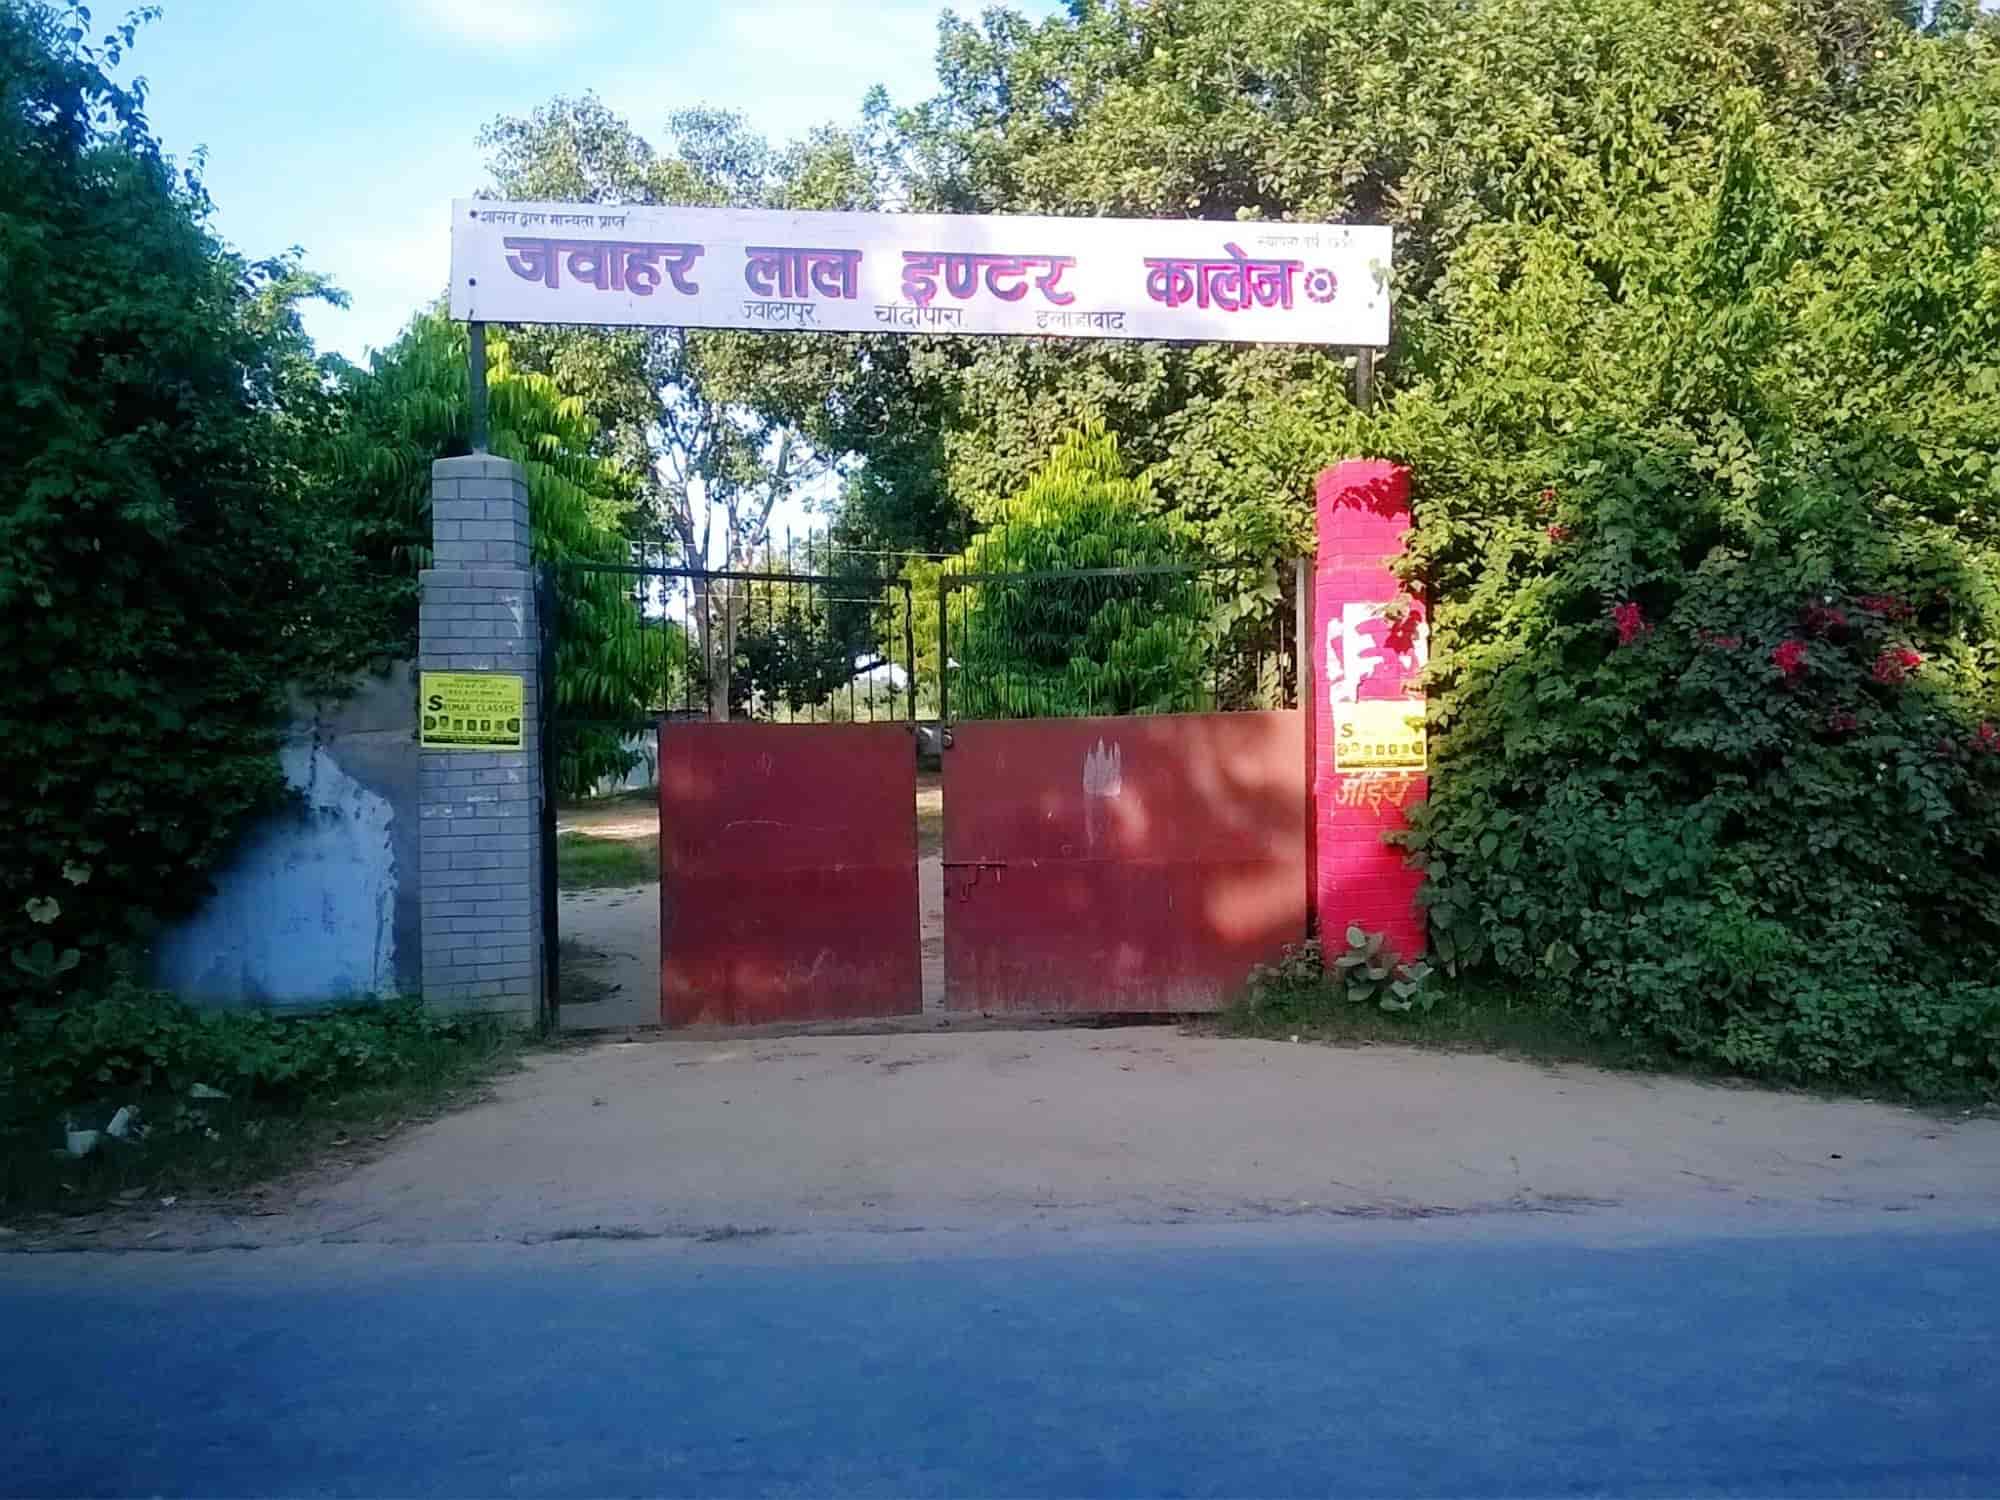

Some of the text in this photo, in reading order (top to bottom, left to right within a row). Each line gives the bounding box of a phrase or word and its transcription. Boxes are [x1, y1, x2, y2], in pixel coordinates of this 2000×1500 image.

[503, 236, 1304, 311] जवाहर लाल इण्टर कालेज
[476, 704, 515, 713] CLASSES
